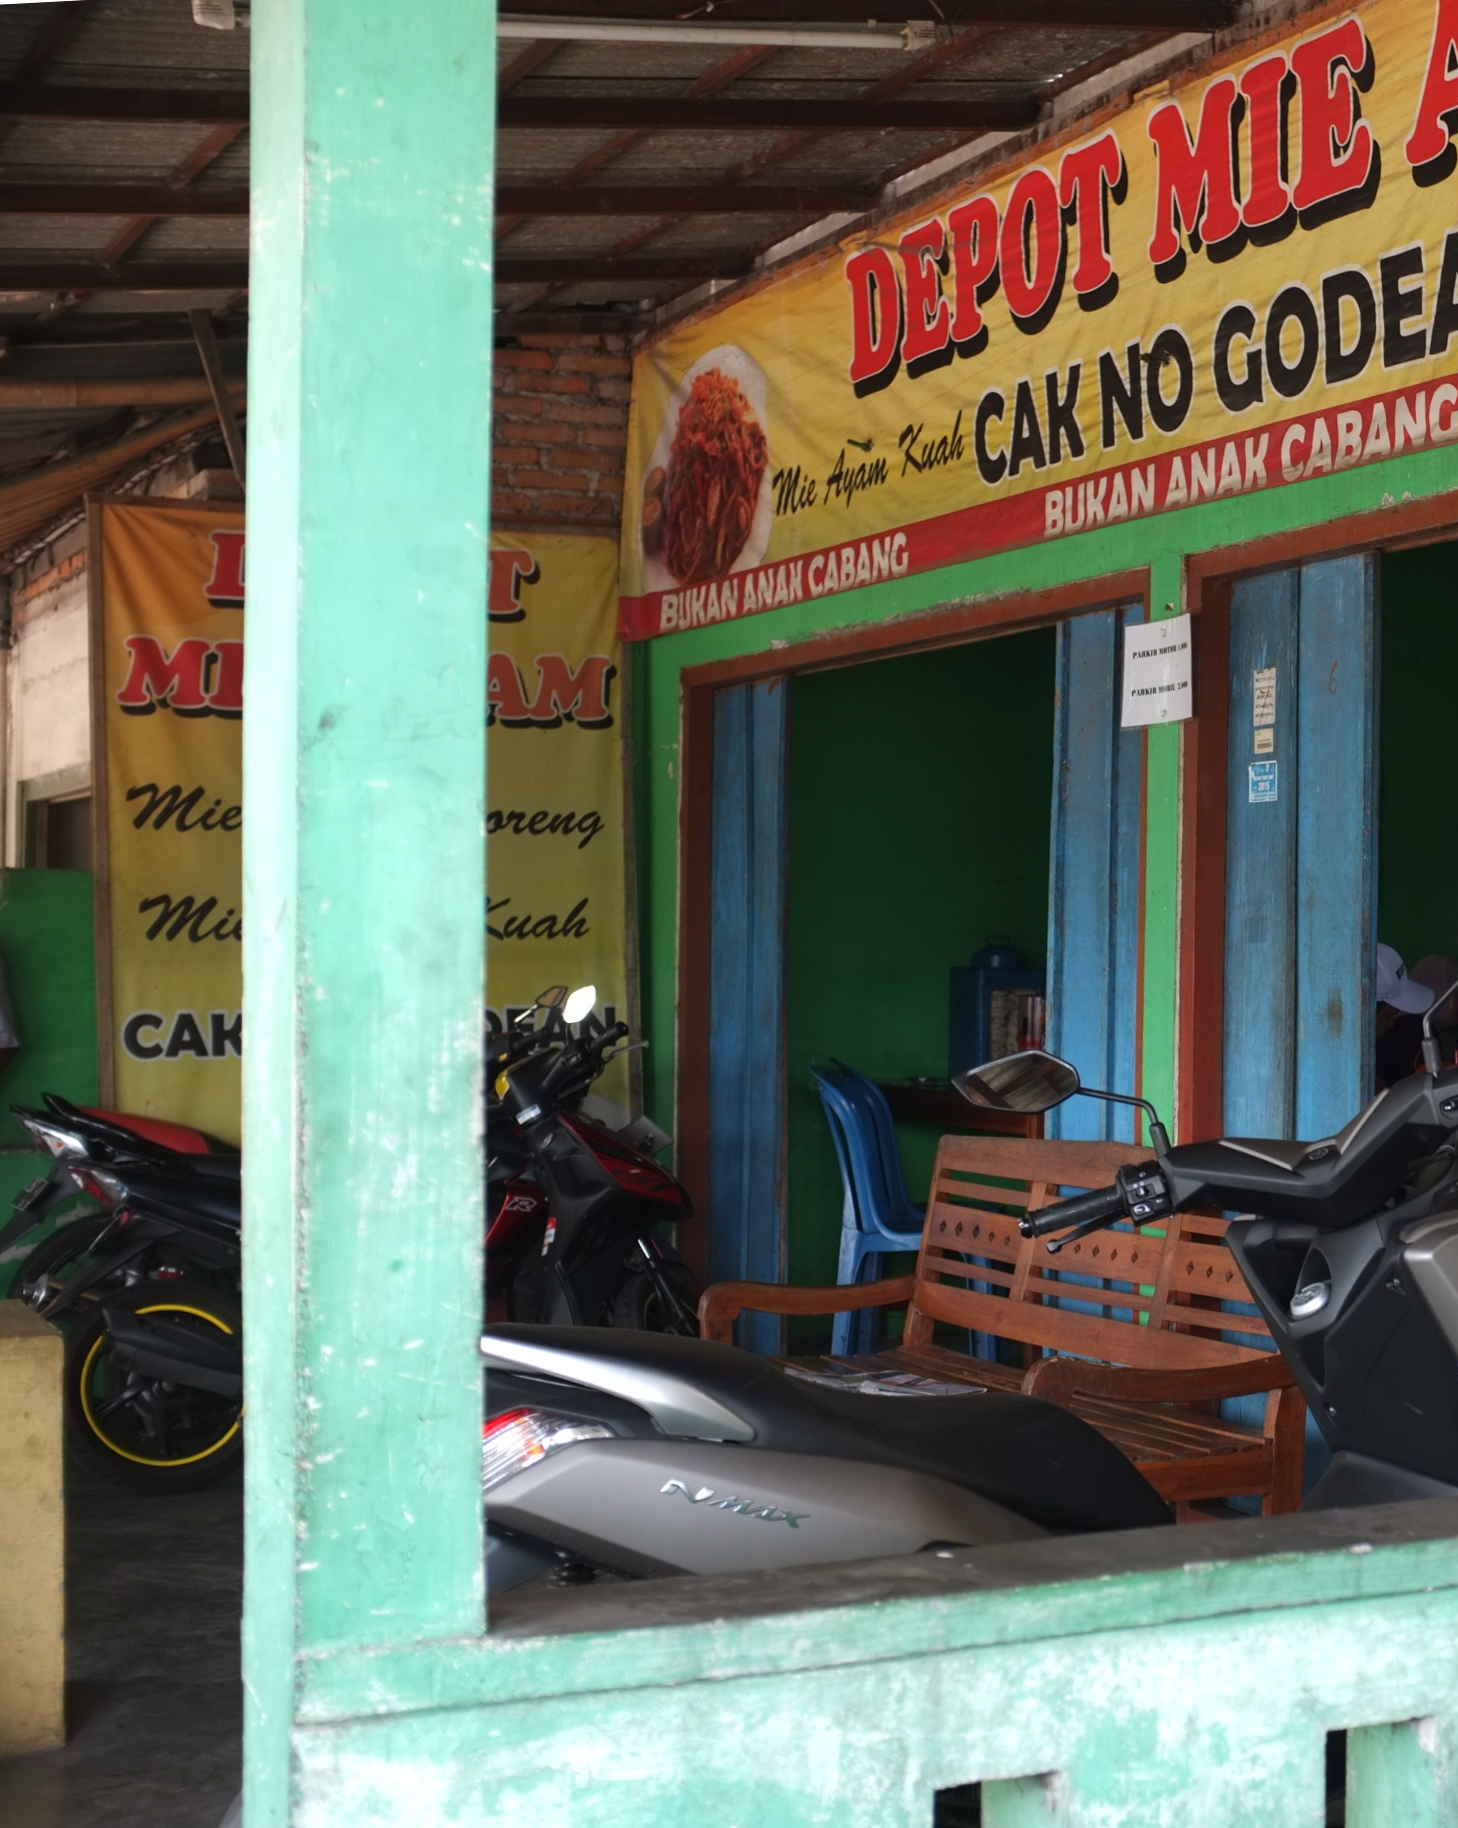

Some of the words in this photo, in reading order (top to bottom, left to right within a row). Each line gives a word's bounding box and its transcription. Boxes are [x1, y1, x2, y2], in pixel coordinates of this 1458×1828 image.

[845, 128, 1126, 392] DEPOT
[1148, 16, 1380, 278] MIE
[973, 362, 1085, 485] CAK
[1099, 327, 1194, 450] NO
[772, 470, 819, 517] Mie
[824, 451, 890, 507] Ayam
[898, 409, 965, 479] Kuah
[1043, 467, 1157, 538] BUKAN
[1163, 433, 1273, 501] ANAK
[659, 578, 738, 634] BUKAN
[742, 559, 806, 614] ANAK
[807, 531, 911, 596] CABANG
[117, 635, 243, 714] MI
[487, 652, 618, 728] AM
[126, 783, 242, 831] Mie
[486, 810, 605, 850] oreng
[124, 1010, 242, 1060] CAK
